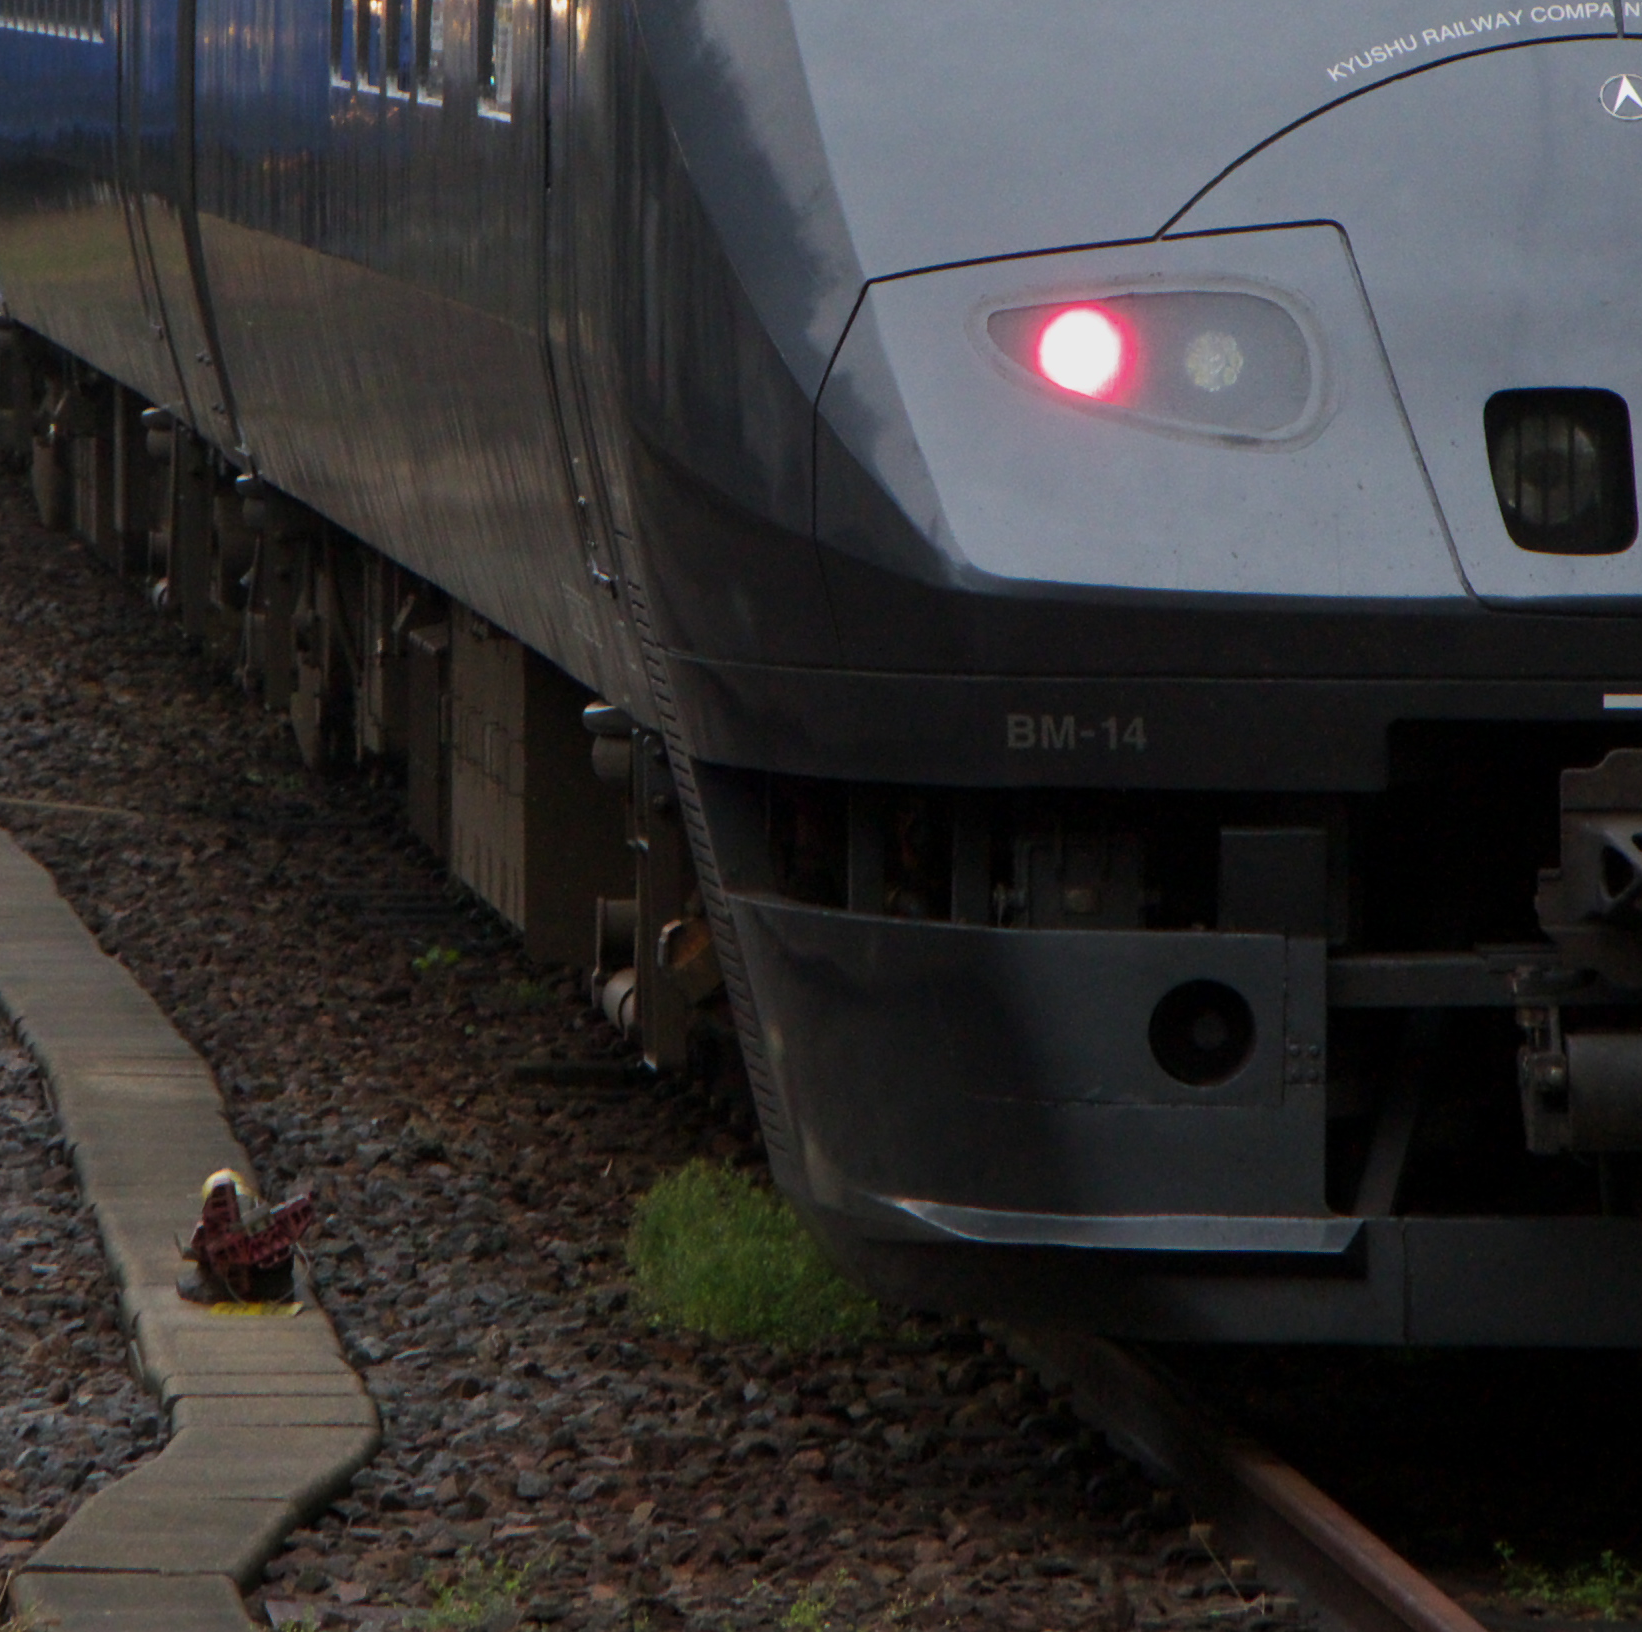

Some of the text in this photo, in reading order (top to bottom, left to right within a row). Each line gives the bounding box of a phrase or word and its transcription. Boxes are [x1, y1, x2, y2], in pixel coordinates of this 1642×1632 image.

[1326, 34, 1418, 81] KYUSHU
[1422, 9, 1523, 46] RAILWAY
[1007, 714, 1147, 754] BM-14
